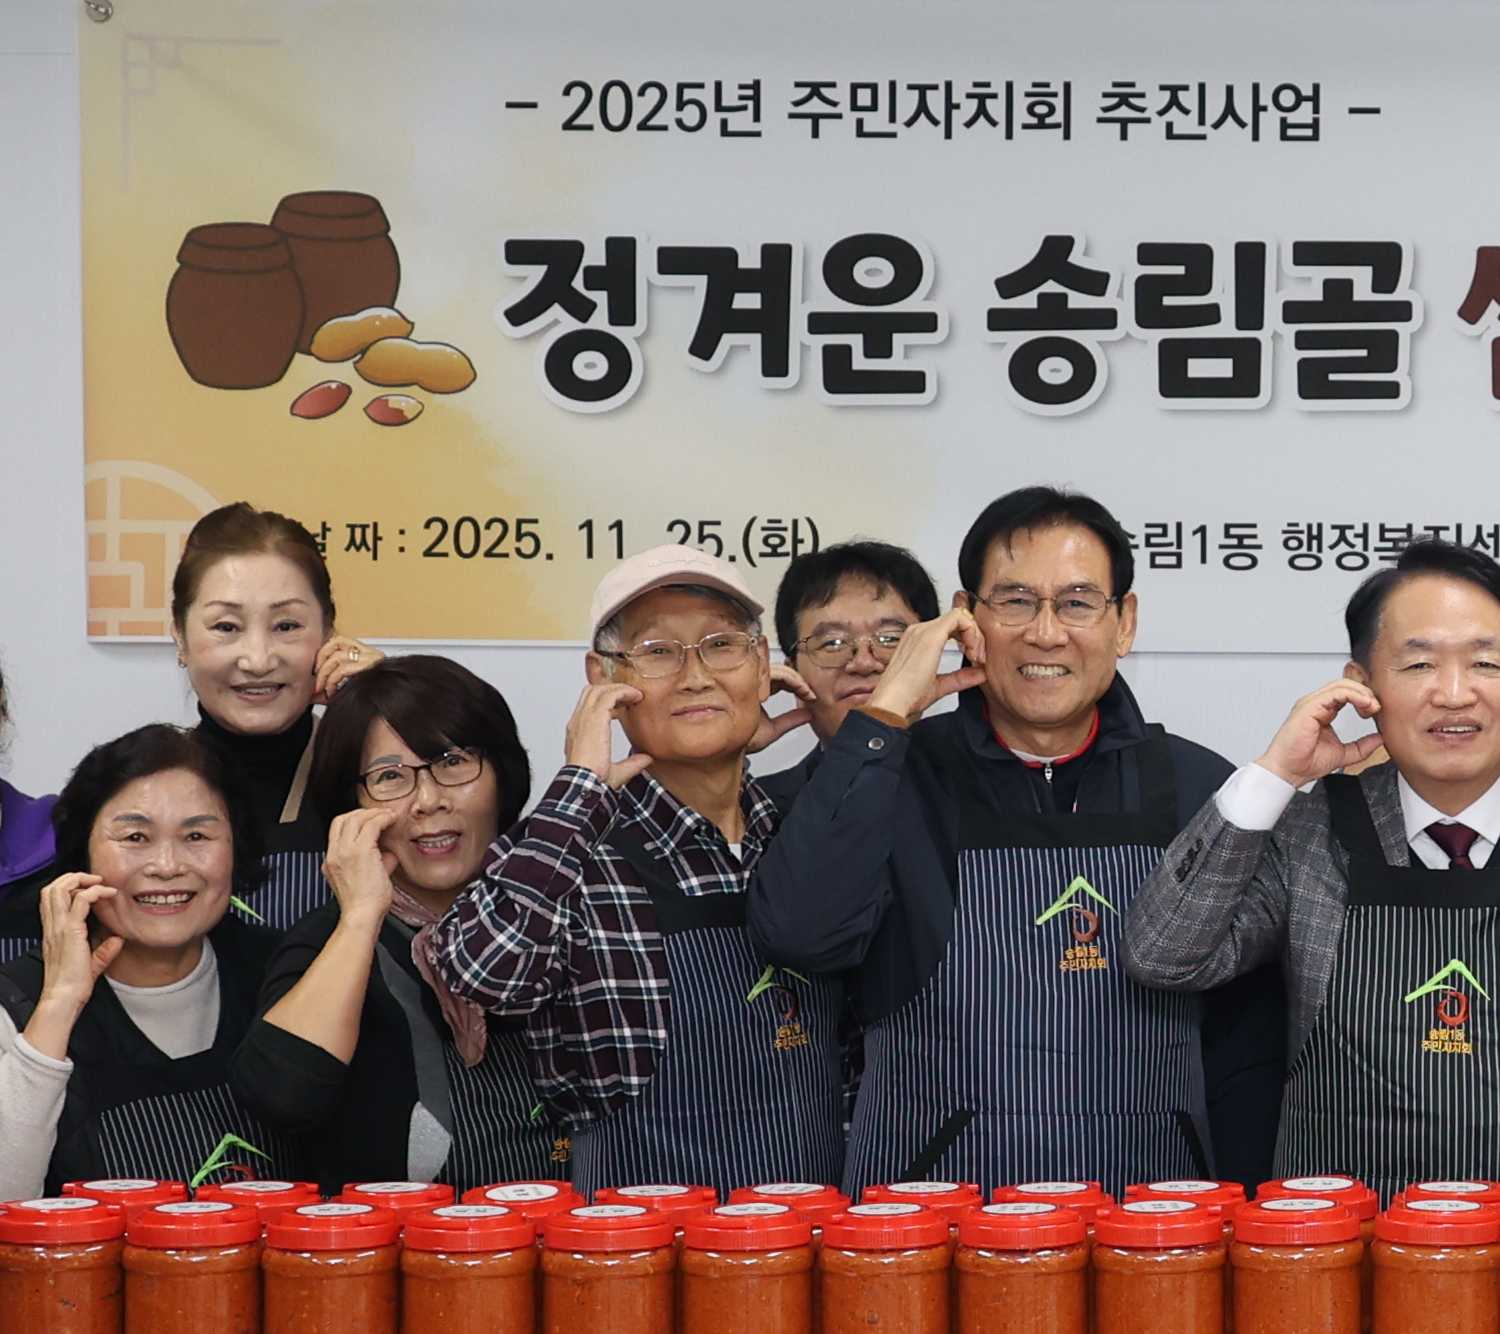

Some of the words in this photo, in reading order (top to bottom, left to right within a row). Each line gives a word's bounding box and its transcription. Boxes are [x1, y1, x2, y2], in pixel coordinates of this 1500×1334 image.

[561, 79, 762, 138] 2025년
[787, 80, 1072, 140] 주민자치회
[1095, 81, 1321, 142] 추진사업
[503, 233, 938, 402] 정겨운
[987, 235, 1413, 405] 송림골
[422, 516, 554, 561] 2025.
